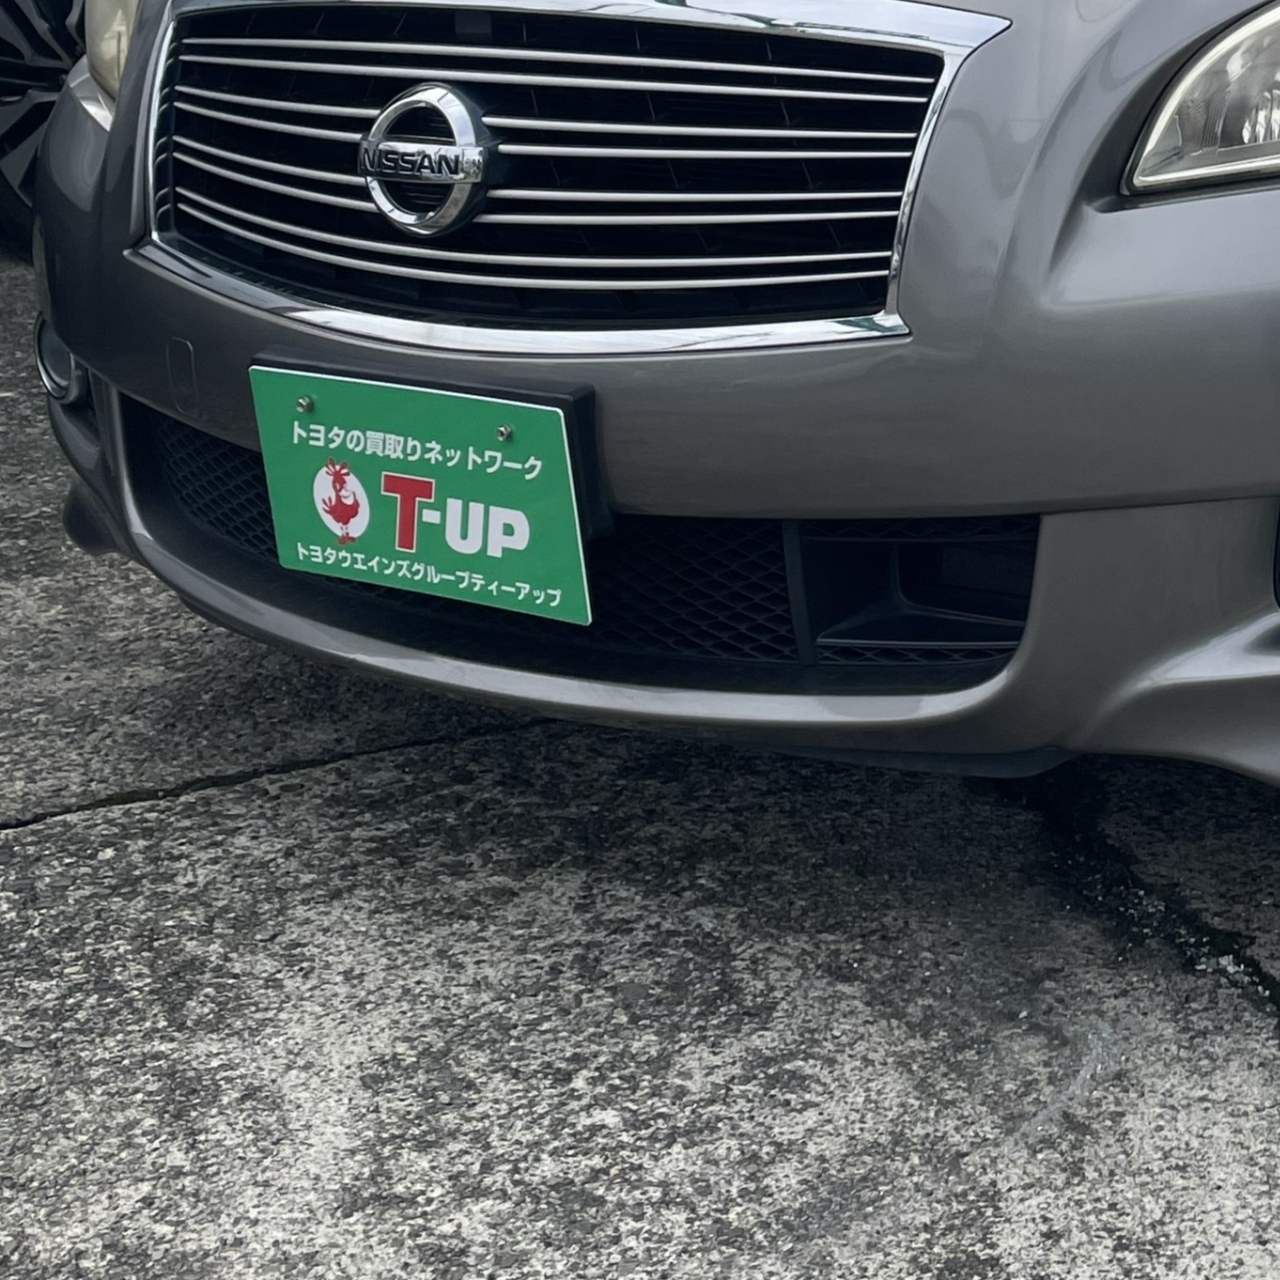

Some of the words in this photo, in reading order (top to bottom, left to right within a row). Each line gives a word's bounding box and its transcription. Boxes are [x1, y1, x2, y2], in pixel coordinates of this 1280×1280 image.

[361, 148, 461, 175] NISSAN
[292, 421, 543, 481] トヨタの買取りネットワーク
[381, 471, 531, 558] T-UP
[296, 542, 562, 607] トヨタウエインズグループティーアップ
